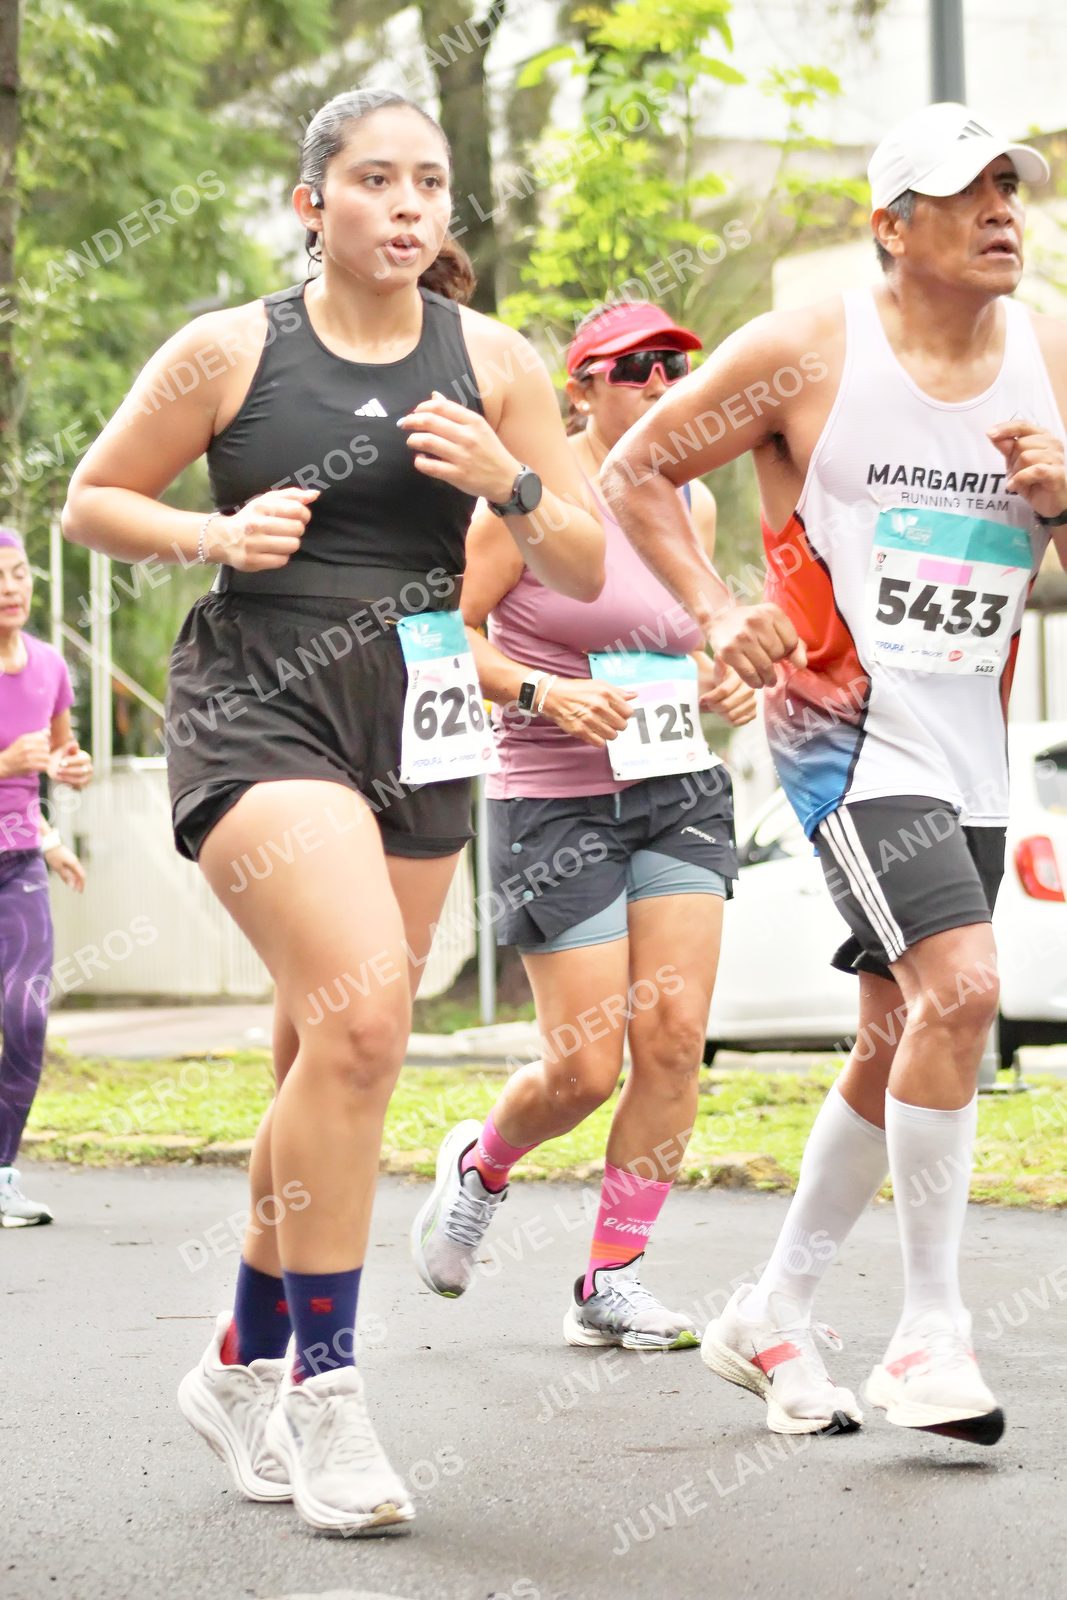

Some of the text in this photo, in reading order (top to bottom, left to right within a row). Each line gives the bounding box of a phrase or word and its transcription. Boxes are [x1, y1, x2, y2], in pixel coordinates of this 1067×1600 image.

[867, 464, 1018, 495] MARGARIT
[966, 498, 1009, 512] TEAM
[875, 577, 1009, 638] 5433
[974, 665, 995, 673] 5433
